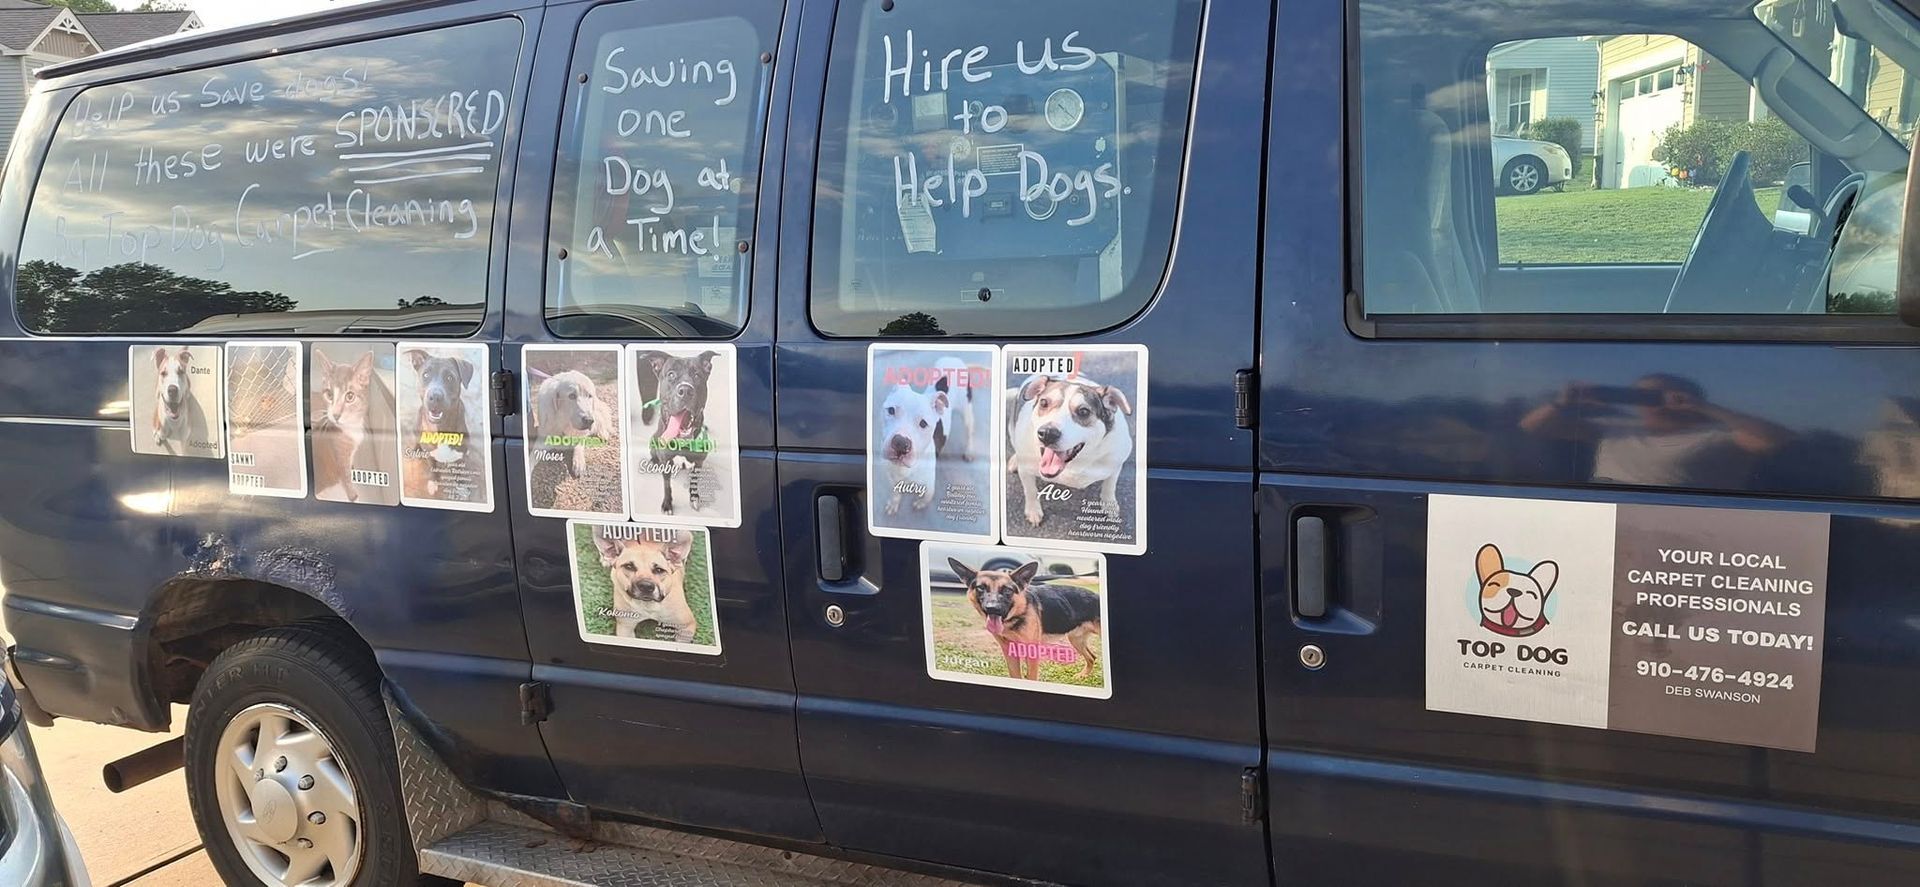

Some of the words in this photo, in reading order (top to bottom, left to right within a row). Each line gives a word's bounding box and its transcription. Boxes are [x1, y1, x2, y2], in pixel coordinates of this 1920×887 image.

[602, 46, 738, 106] Saving
[883, 29, 993, 103] Hire
[1016, 30, 1097, 75] us
[151, 90, 181, 116] us
[199, 76, 265, 108] Save
[616, 108, 692, 138] one
[953, 99, 1009, 135] to
[63, 150, 109, 193] All
[134, 144, 223, 185] these
[245, 134, 316, 164] were
[603, 156, 674, 215] Dog
[696, 158, 730, 191] at
[894, 152, 989, 219] Help
[101, 210, 163, 267] Top
[171, 205, 225, 271] Dog
[235, 183, 337, 253] Carpet
[346, 188, 480, 239] Cleaning
[586, 225, 613, 259] a
[626, 215, 721, 262] Time!
[190, 366, 211, 376] Dante
[1013, 357, 1073, 373] ADOPTED
[883, 365, 991, 389] ADOPTED!
[188, 440, 219, 450] Adopted
[419, 431, 464, 447] ADOPTED!
[543, 434, 608, 448] ADOPTED!
[648, 437, 718, 454] ADOPTED!
[534, 449, 565, 462] Moses
[351, 470, 389, 486] ADOPTED
[638, 459, 681, 477] Scooby
[231, 477, 265, 489] ADOPTED
[893, 480, 928, 496] Autry
[1037, 484, 1072, 501] Ace
[602, 524, 678, 544] ADOPTED!
[1079, 523, 1091, 531] dog
[1658, 549, 1713, 566] YOUR
[1719, 552, 1787, 569] LOCAL
[1627, 569, 1706, 588] CARPET
[1711, 575, 1814, 595] CLEANING
[597, 606, 640, 619] Kokomo
[1636, 592, 1801, 617] PROFESSIONALS
[1622, 621, 1681, 639] CALL
[1688, 626, 1720, 642] US
[1727, 629, 1814, 651] TODAY!
[1007, 641, 1077, 664] ADOPTED
[1457, 639, 1506, 658] TOP
[1517, 645, 1568, 665] DOG
[1463, 661, 1504, 671] CARPET
[1507, 666, 1561, 677] CLEANING
[1636, 660, 1794, 690] 910-476-4924
[1665, 685, 1692, 697] DEB
[1695, 688, 1761, 704] SWANSON
